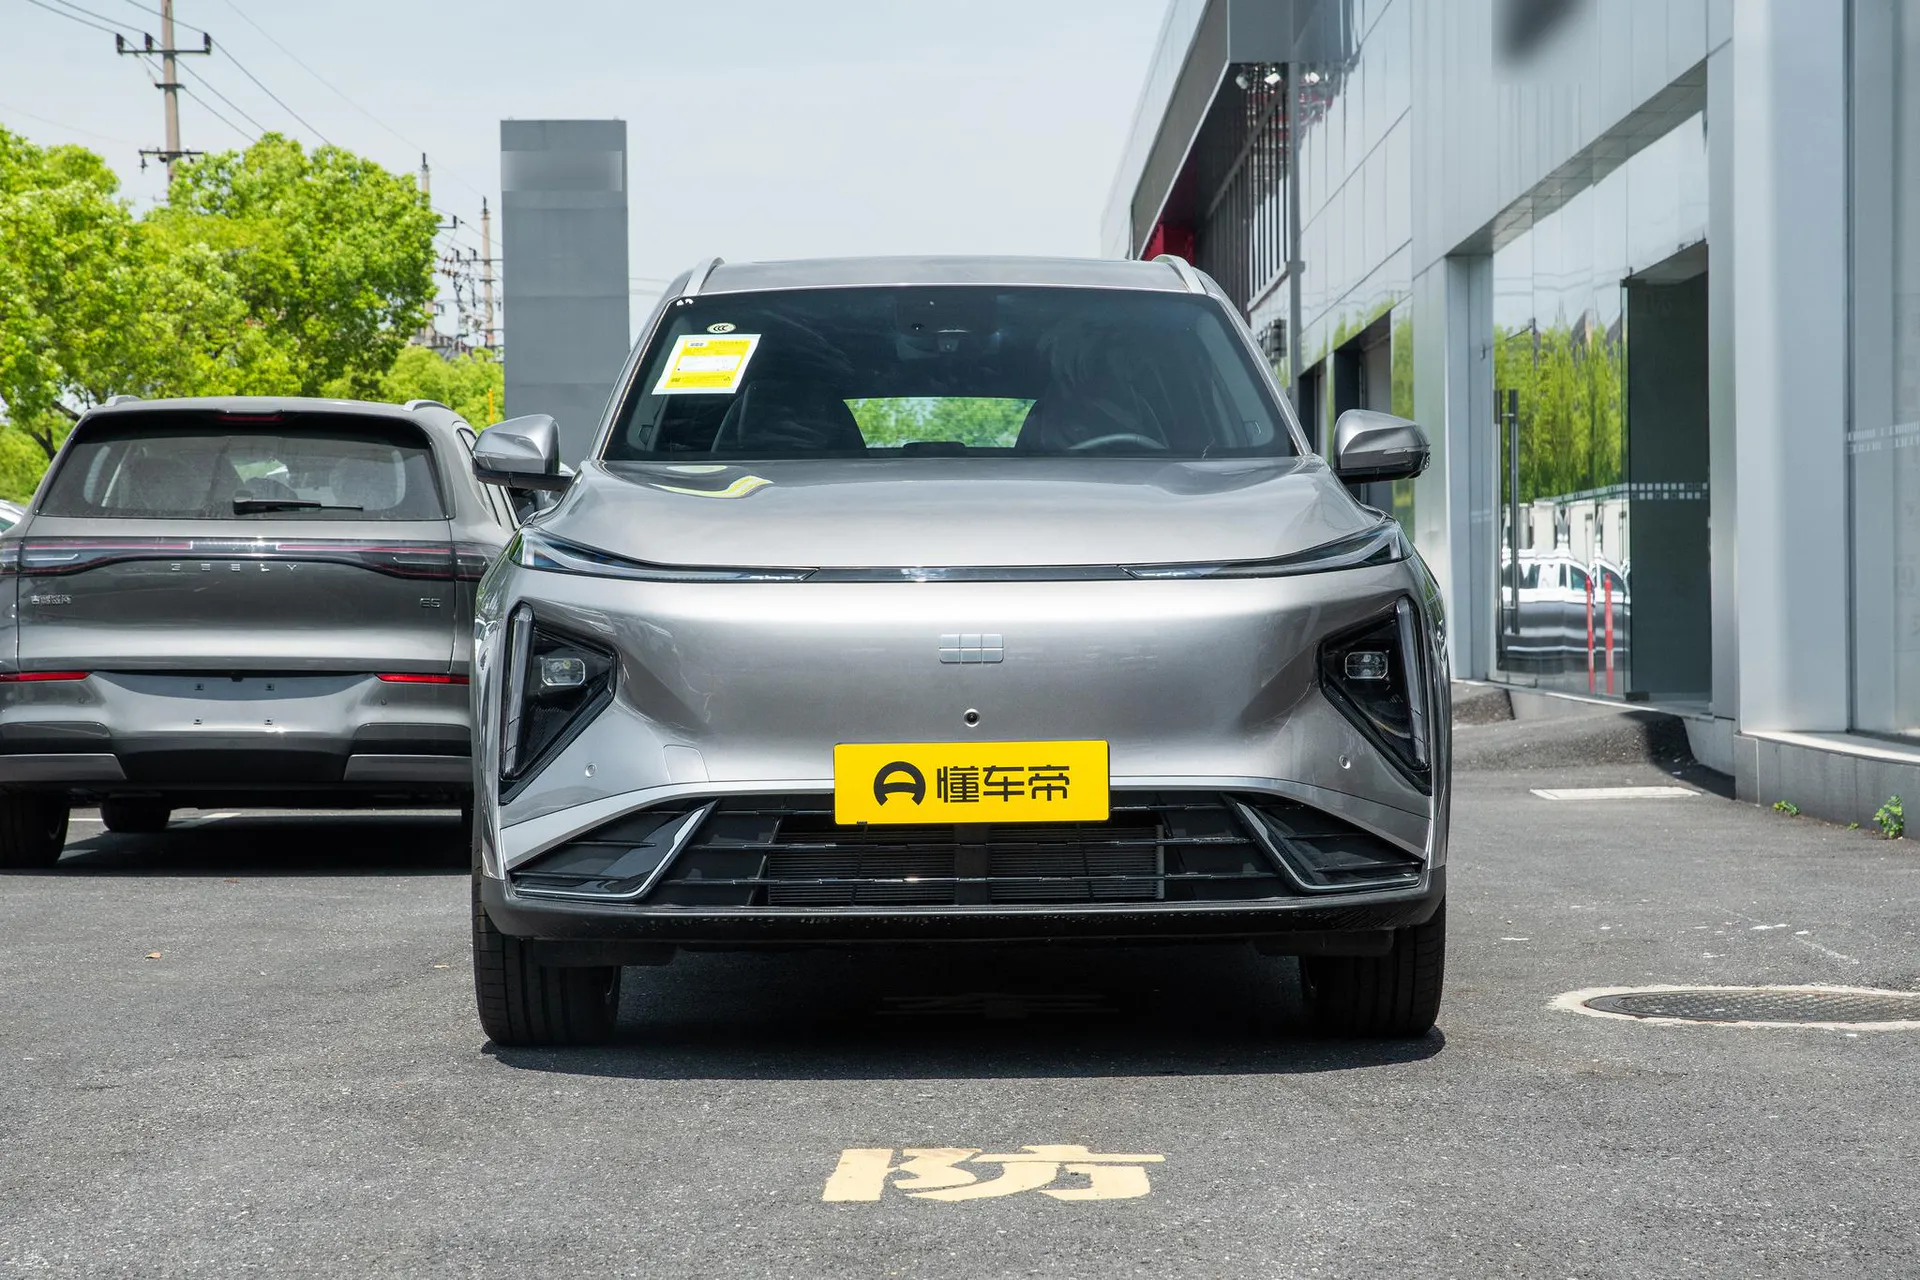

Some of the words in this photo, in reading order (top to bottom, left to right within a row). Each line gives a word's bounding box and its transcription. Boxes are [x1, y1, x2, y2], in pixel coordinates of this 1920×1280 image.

[171, 563, 297, 572] GEELY
[936, 764, 1070, 803] 懂车帝
